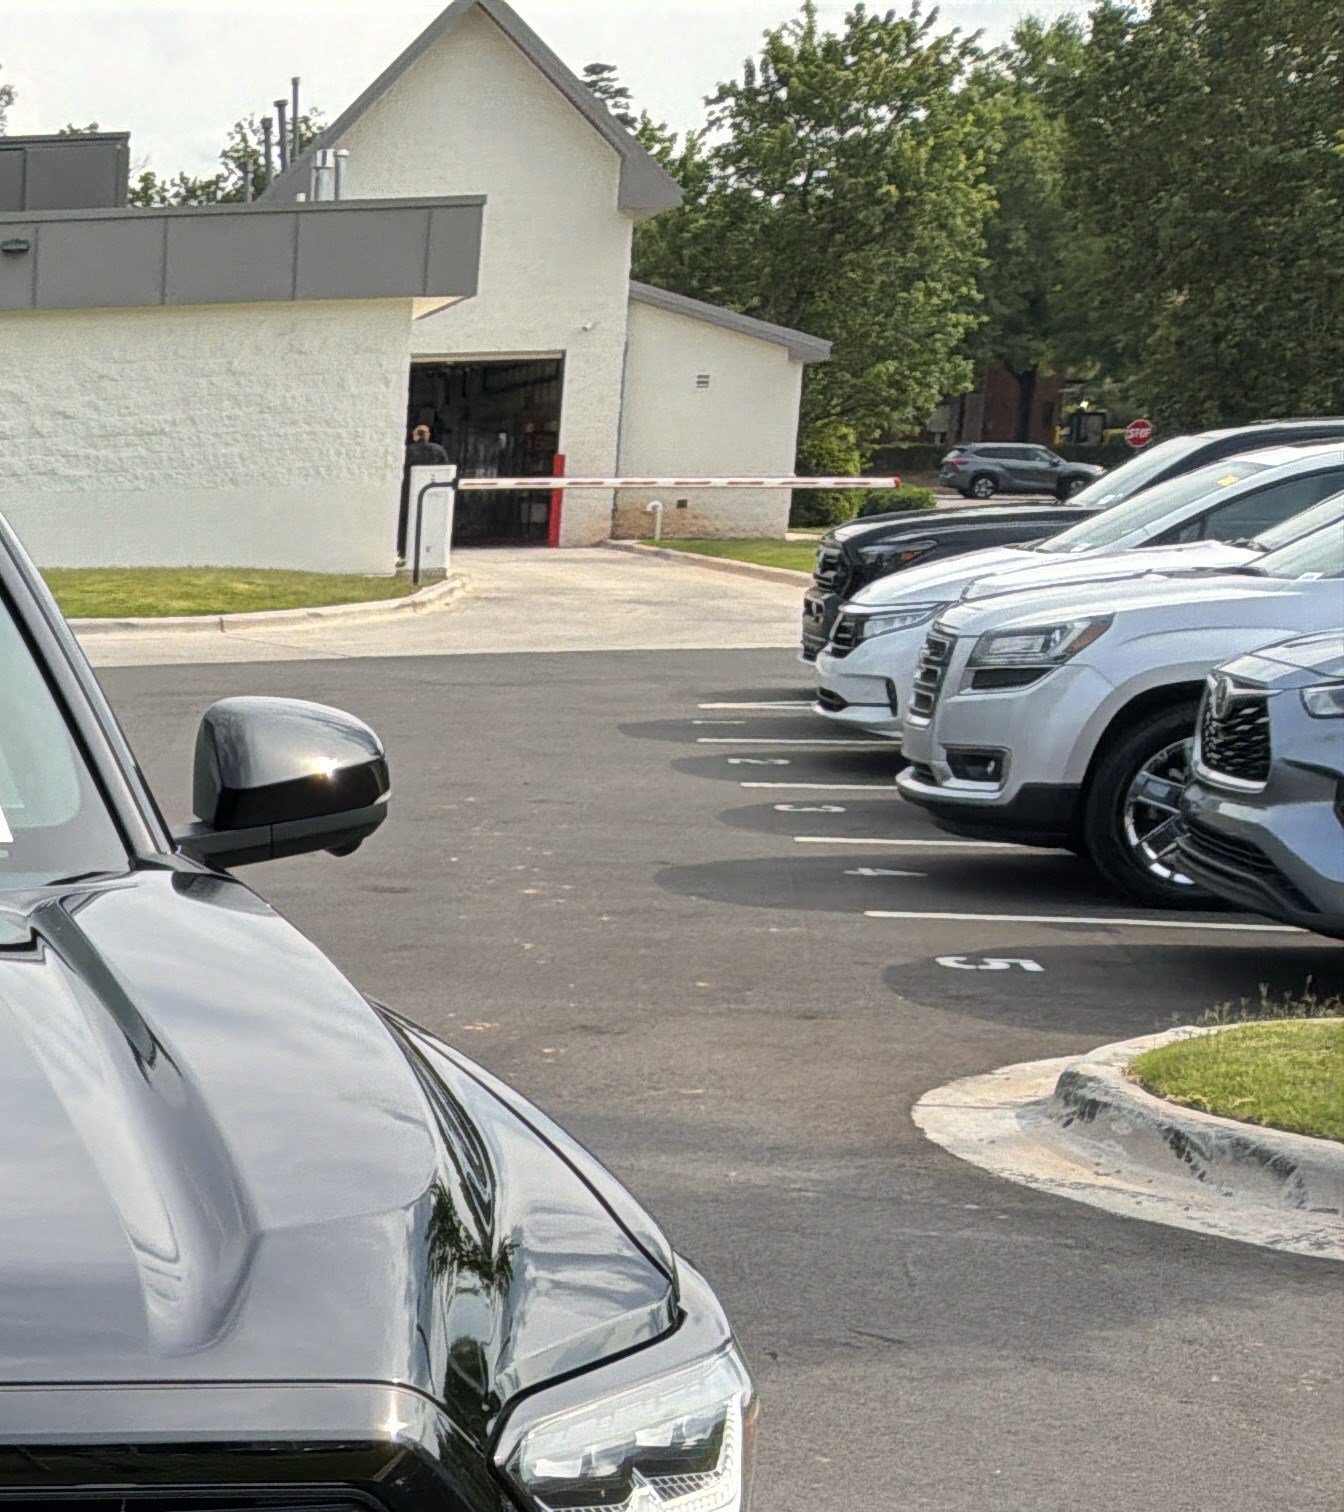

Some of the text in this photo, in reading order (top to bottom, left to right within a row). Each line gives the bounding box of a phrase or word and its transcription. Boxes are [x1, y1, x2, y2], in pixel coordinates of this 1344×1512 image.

[1128, 428, 1152, 439] STOP
[773, 804, 847, 813] 3
[935, 956, 1046, 972] 5
